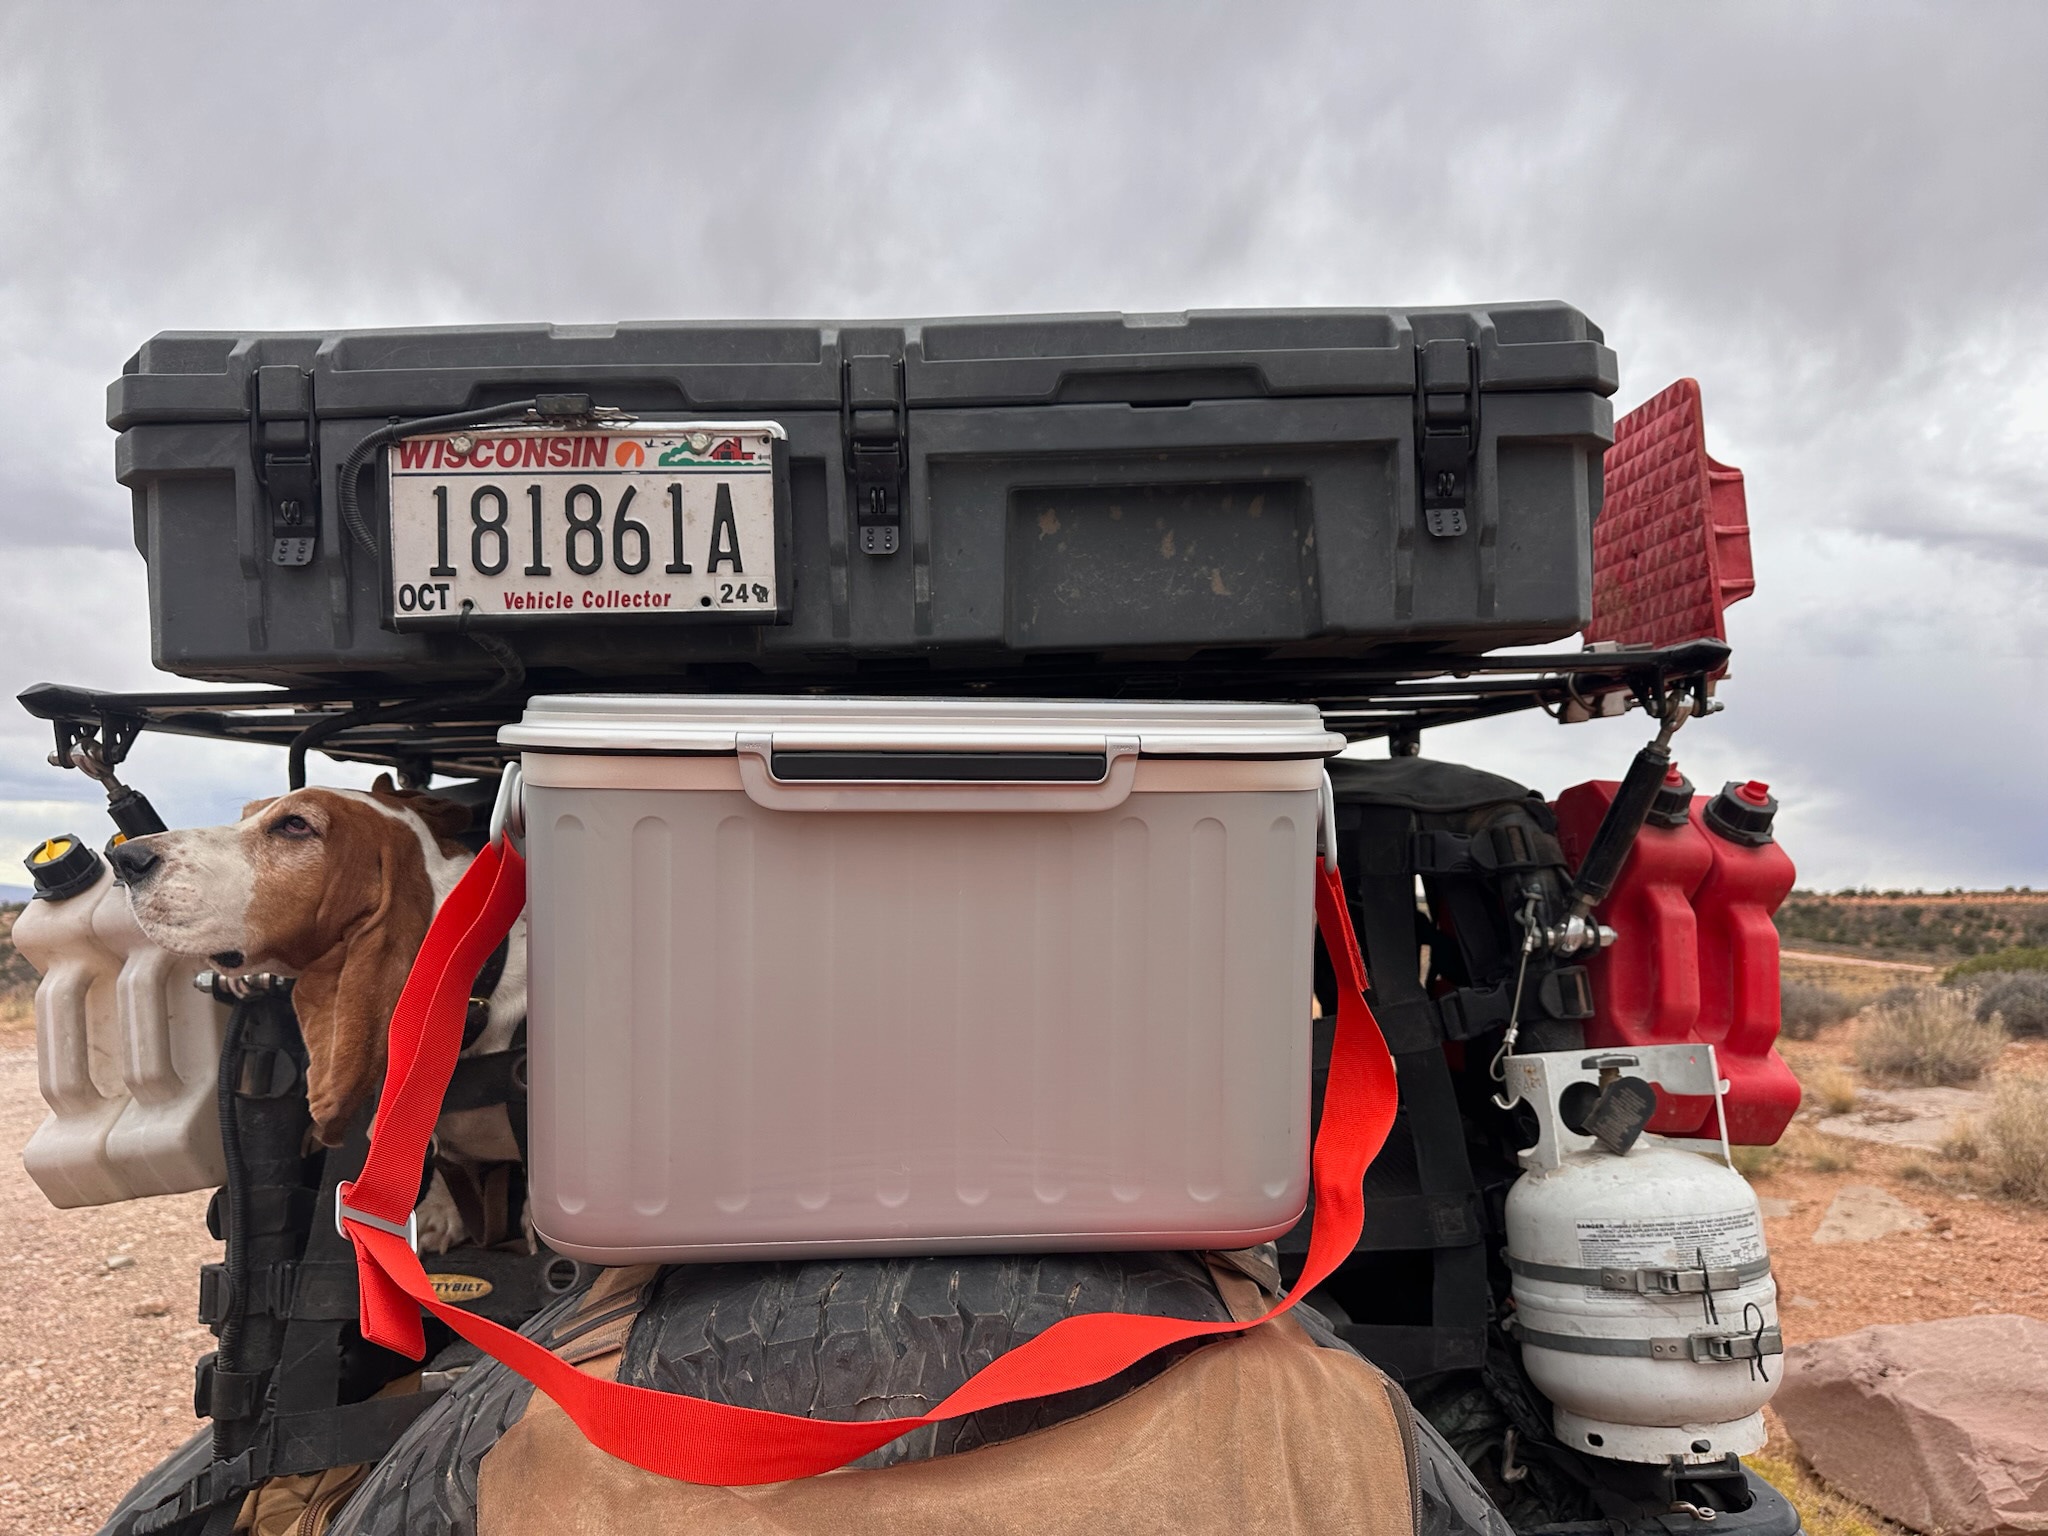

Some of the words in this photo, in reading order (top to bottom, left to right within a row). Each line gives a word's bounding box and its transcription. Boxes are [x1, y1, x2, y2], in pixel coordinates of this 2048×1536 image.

[400, 437, 609, 469] WISCONSIN
[429, 482, 744, 577] 181861A
[398, 583, 450, 611] OCT
[503, 591, 574, 610] Vehicle
[582, 590, 671, 609] Collector
[719, 583, 749, 604] 24
[431, 1282, 483, 1291] TYBILT
